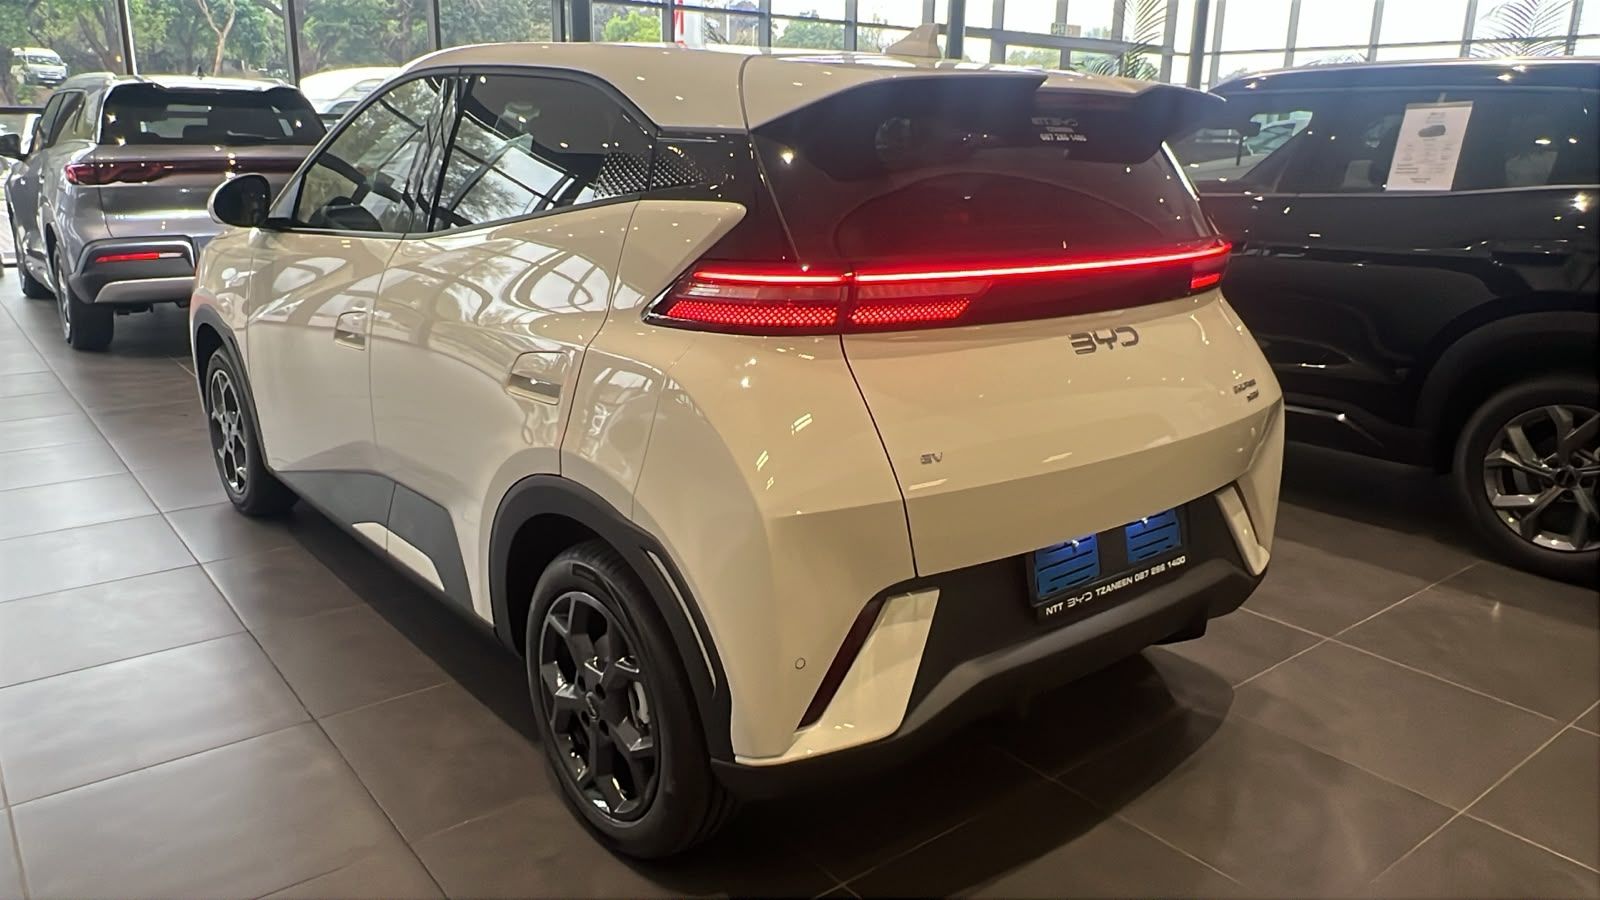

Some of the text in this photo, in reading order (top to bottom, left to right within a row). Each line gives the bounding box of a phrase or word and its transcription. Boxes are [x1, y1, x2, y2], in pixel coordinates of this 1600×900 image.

[1069, 326, 1139, 355] BYD
[1045, 602, 1064, 616] NTT
[1067, 592, 1093, 608] BYD
[1095, 576, 1133, 597] TZANEEN
[1134, 569, 1149, 582] 087
[1167, 555, 1186, 568] 1400
